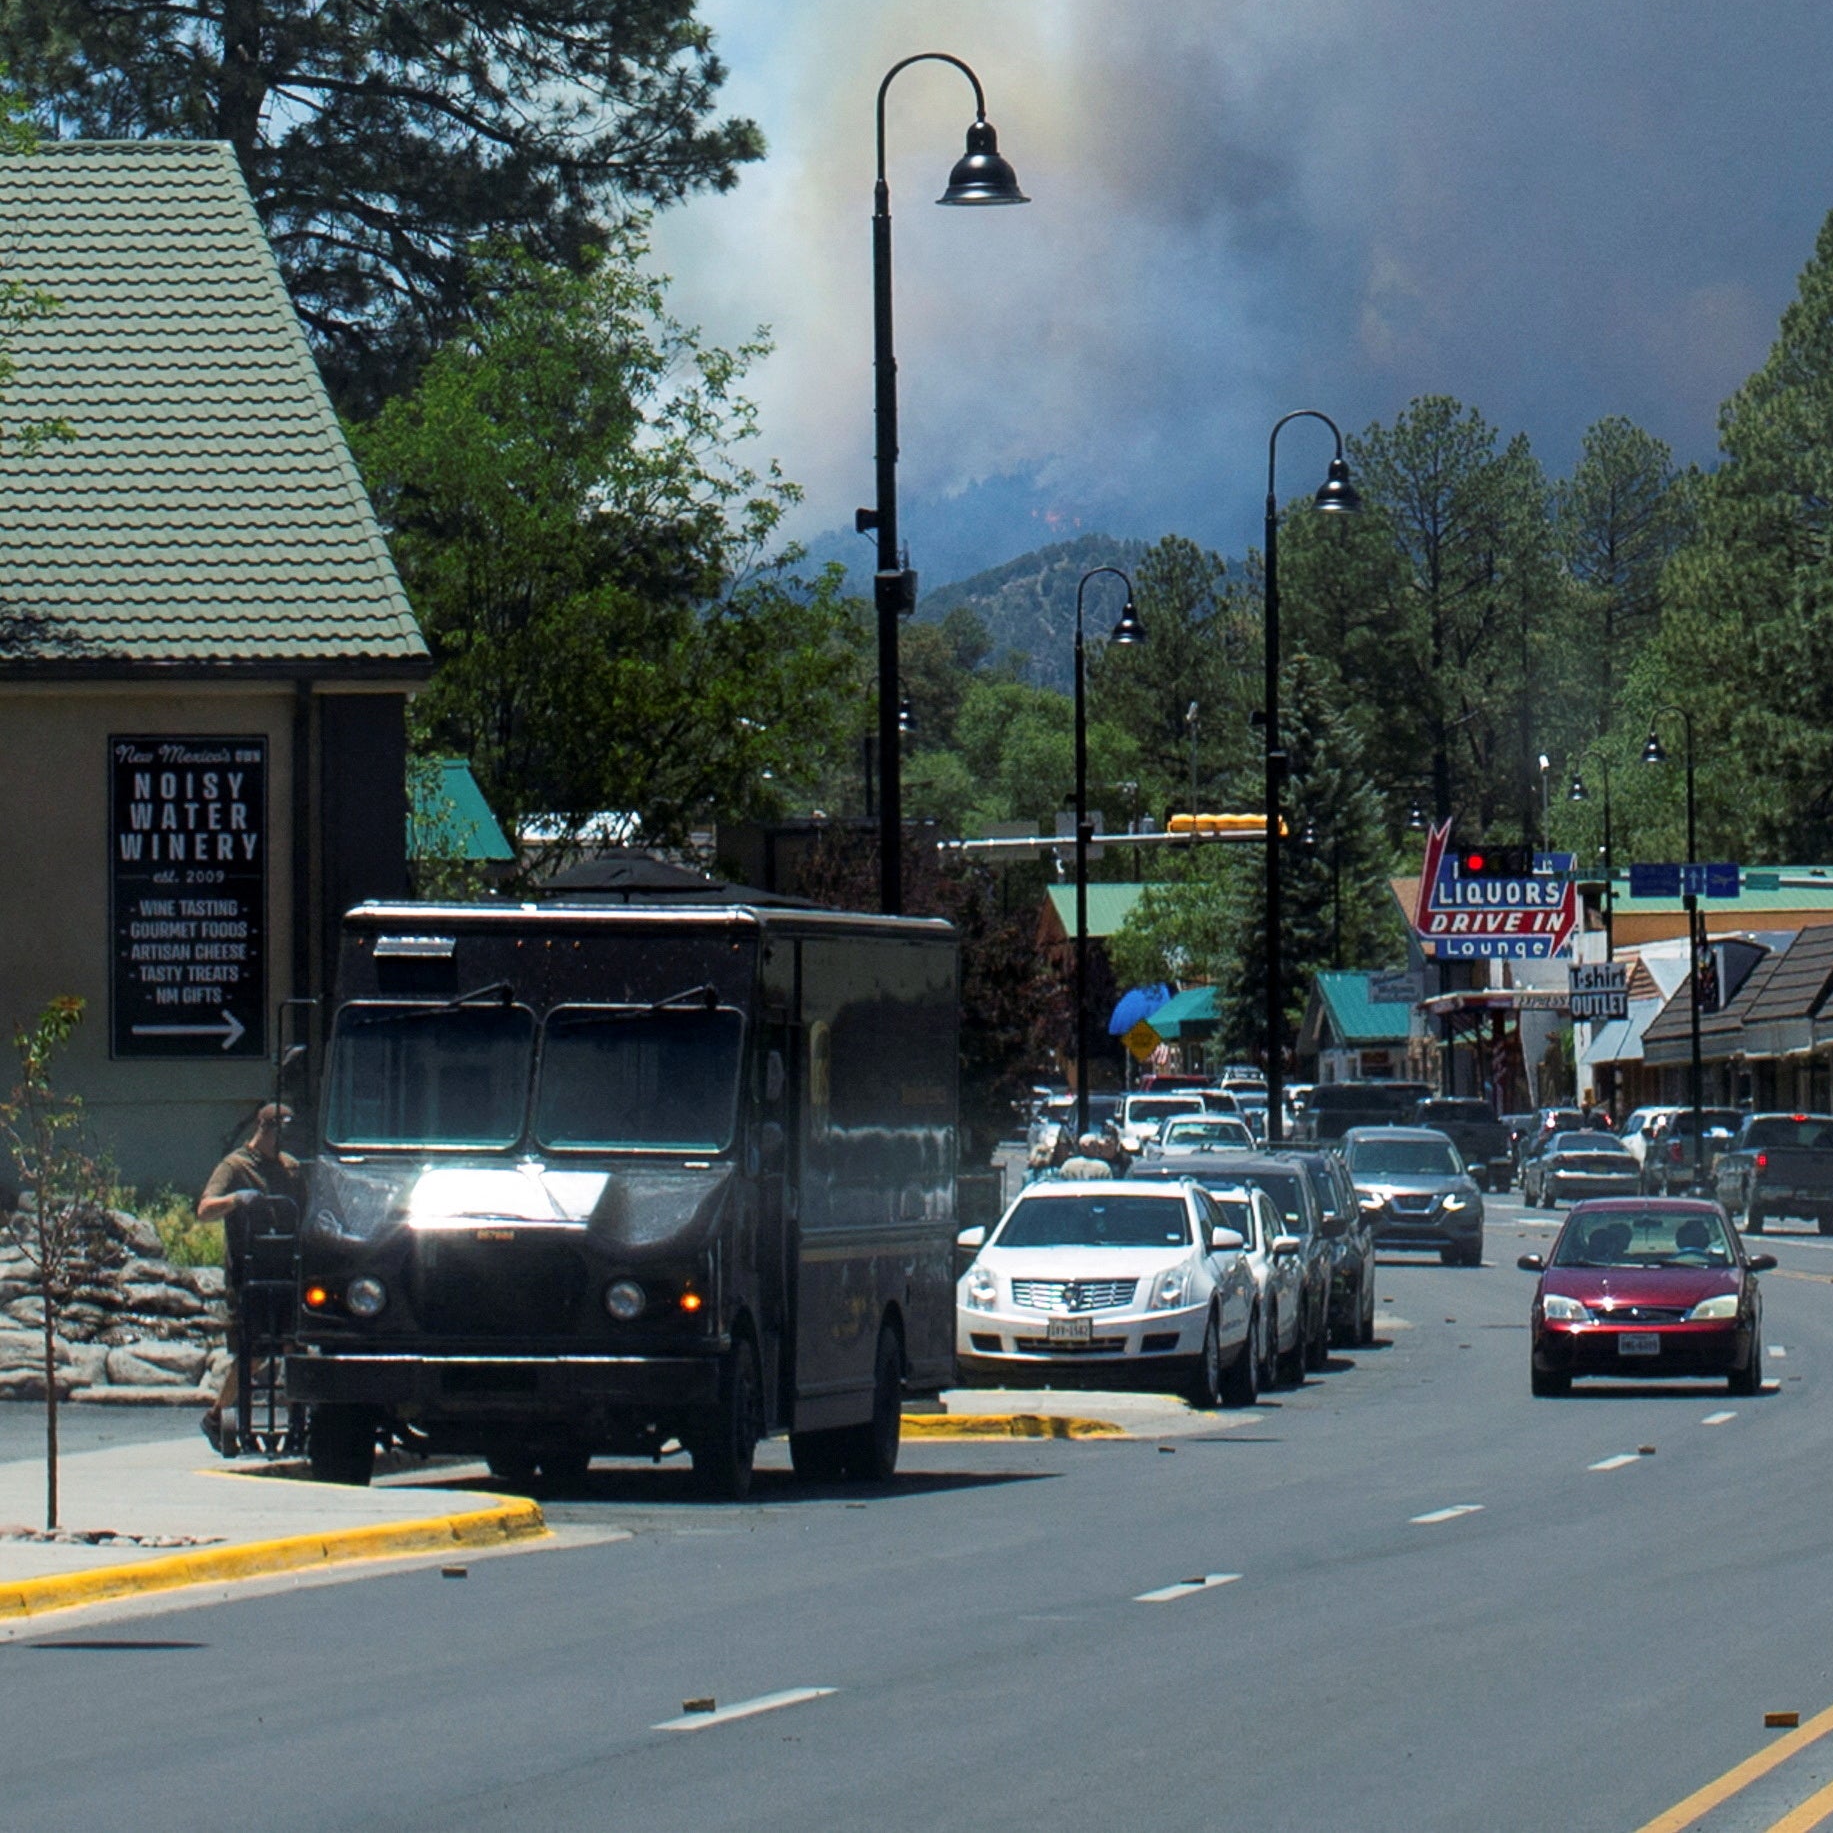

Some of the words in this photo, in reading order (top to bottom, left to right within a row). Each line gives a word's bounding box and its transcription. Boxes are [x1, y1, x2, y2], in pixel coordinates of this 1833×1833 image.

[116, 744, 154, 764] New
[158, 744, 231, 764] Mexico's
[134, 772, 243, 800] NOISY
[130, 802, 247, 830] WATER
[120, 833, 257, 860] WINERY
[153, 870, 180, 883] est.
[186, 870, 225, 884] 2009
[1438, 882, 1560, 904] LIQUORS
[139, 899, 176, 916] WINE
[179, 899, 238, 916] TASTING
[130, 921, 196, 938] GOURMET
[201, 921, 248, 938] FOODS
[1430, 913, 1523, 932] DRIVE
[1532, 913, 1565, 932] IN
[131, 943, 190, 960] ARTISAN
[195, 943, 247, 960] CHEESE
[1446, 941, 1545, 959] Lounge
[140, 965, 183, 981] TASTY
[187, 965, 239, 981] TREATS
[156, 987, 179, 1004] NM
[182, 987, 222, 1004] GIFTS
[1571, 995, 1626, 1016] OUTLET
